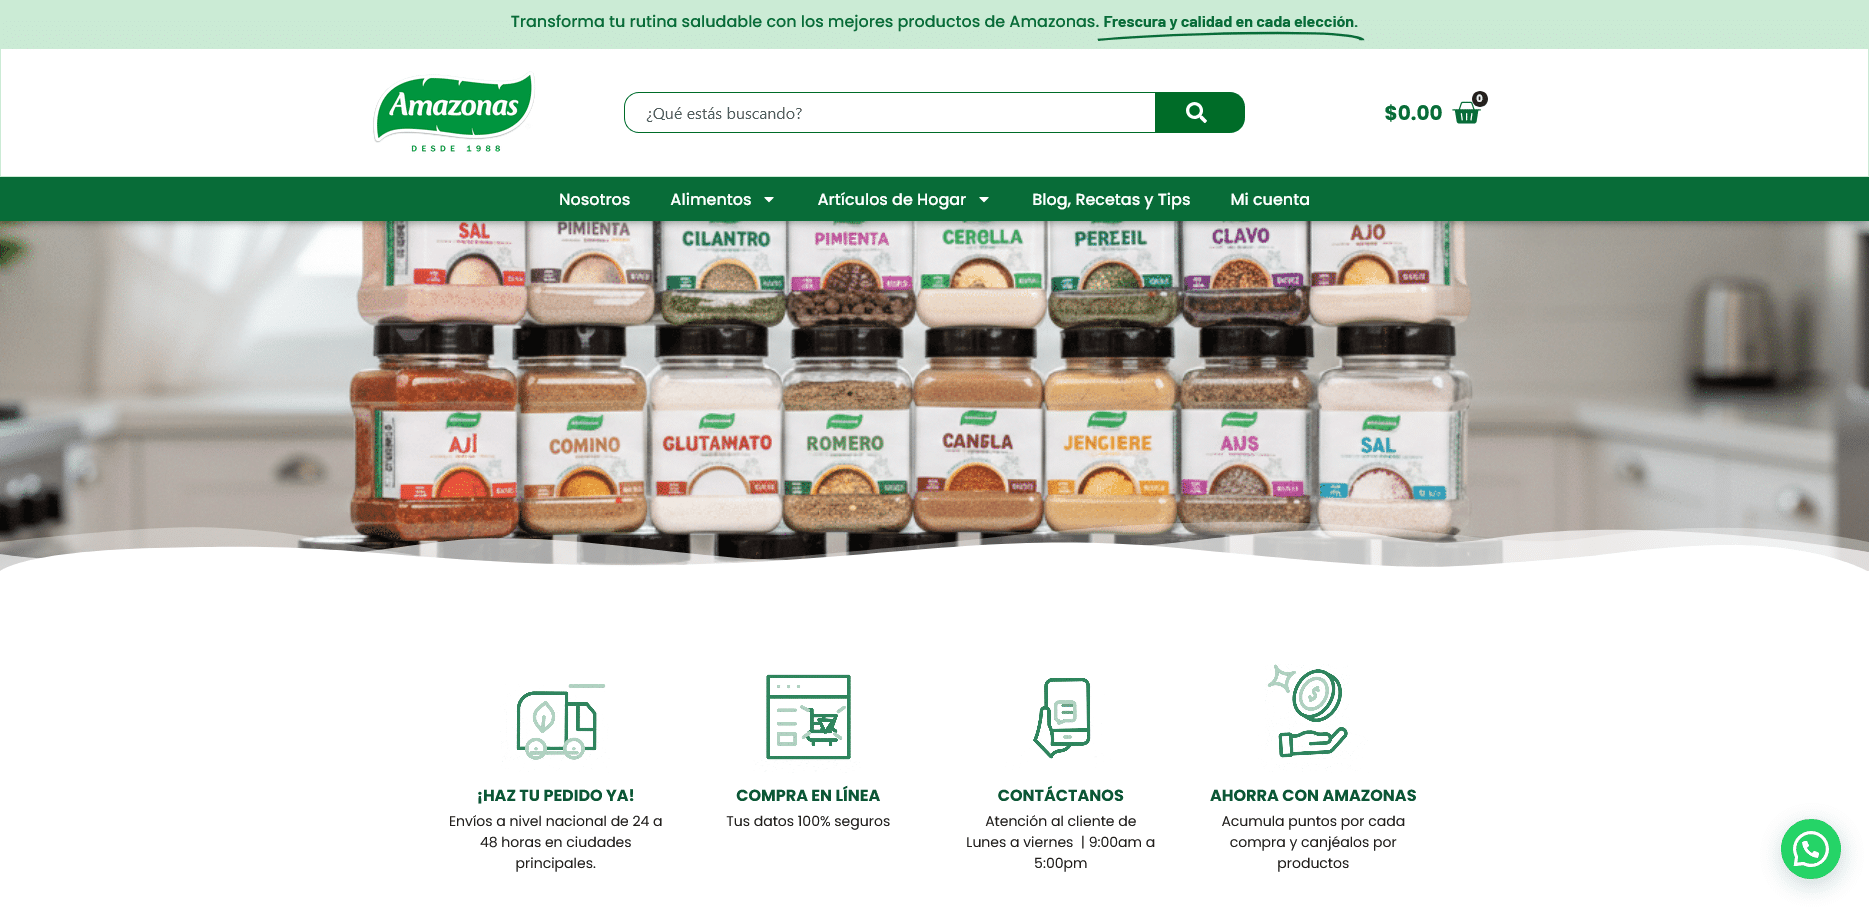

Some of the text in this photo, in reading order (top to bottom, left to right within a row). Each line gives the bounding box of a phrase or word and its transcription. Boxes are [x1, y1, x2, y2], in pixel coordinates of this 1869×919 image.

[511, 15, 1357, 31] Transforma tu rutina saludable con los mejores productos de Amazonas. Frescura y calidad en cada elección.
[389, 91, 519, 116] Amazonas
[1476, 94, 1483, 103] 0
[647, 107, 802, 122] ¿Qué estás buscando?
[1385, 104, 1442, 122] $0.00
[560, 193, 630, 206] Nosotros
[671, 192, 751, 206] Alimentos
[818, 192, 966, 210] Artículos de Hogar
[1033, 192, 1190, 210] Blog, Recetas y Tips
[1231, 192, 1309, 206] Mi cuenta
[459, 222, 490, 239] SAL
[1212, 227, 1270, 244] CLAVO
[1350, 224, 1386, 241] AJO
[683, 231, 770, 247] CILANTRO
[815, 232, 889, 246] PIMIENTA
[549, 437, 620, 455] COMINO
[807, 436, 884, 451] ROMERO
[1361, 437, 1397, 453] SAL
[478, 789, 634, 804] ¡HAZ TU PEDIDO YA!
[736, 786, 880, 801] COMPRA EN LÍNEA
[998, 786, 1123, 801] CONTÁCTANOS
[1210, 789, 1416, 801] AHORRA CON AMAZONAS
[450, 815, 662, 826] Envíos a nivel nacional de 24 a
[727, 815, 890, 830] Tus datos 100% seguros
[986, 815, 1136, 826] Atención al cliente de
[1222, 815, 1405, 830] Acumula puntos por cada
[480, 836, 631, 848] 48 horas en ciudades
[967, 837, 1006, 847] Lunes
[1010, 839, 1019, 847] a
[1023, 836, 1073, 847] viernes
[1089, 836, 1141, 847] 9:00am
[1146, 839, 1155, 847] a
[1230, 836, 1396, 851] compra y canjéalos por
[516, 857, 595, 872] principales.
[1035, 857, 1087, 872] 5:00pm
[1278, 857, 1349, 872] productos
